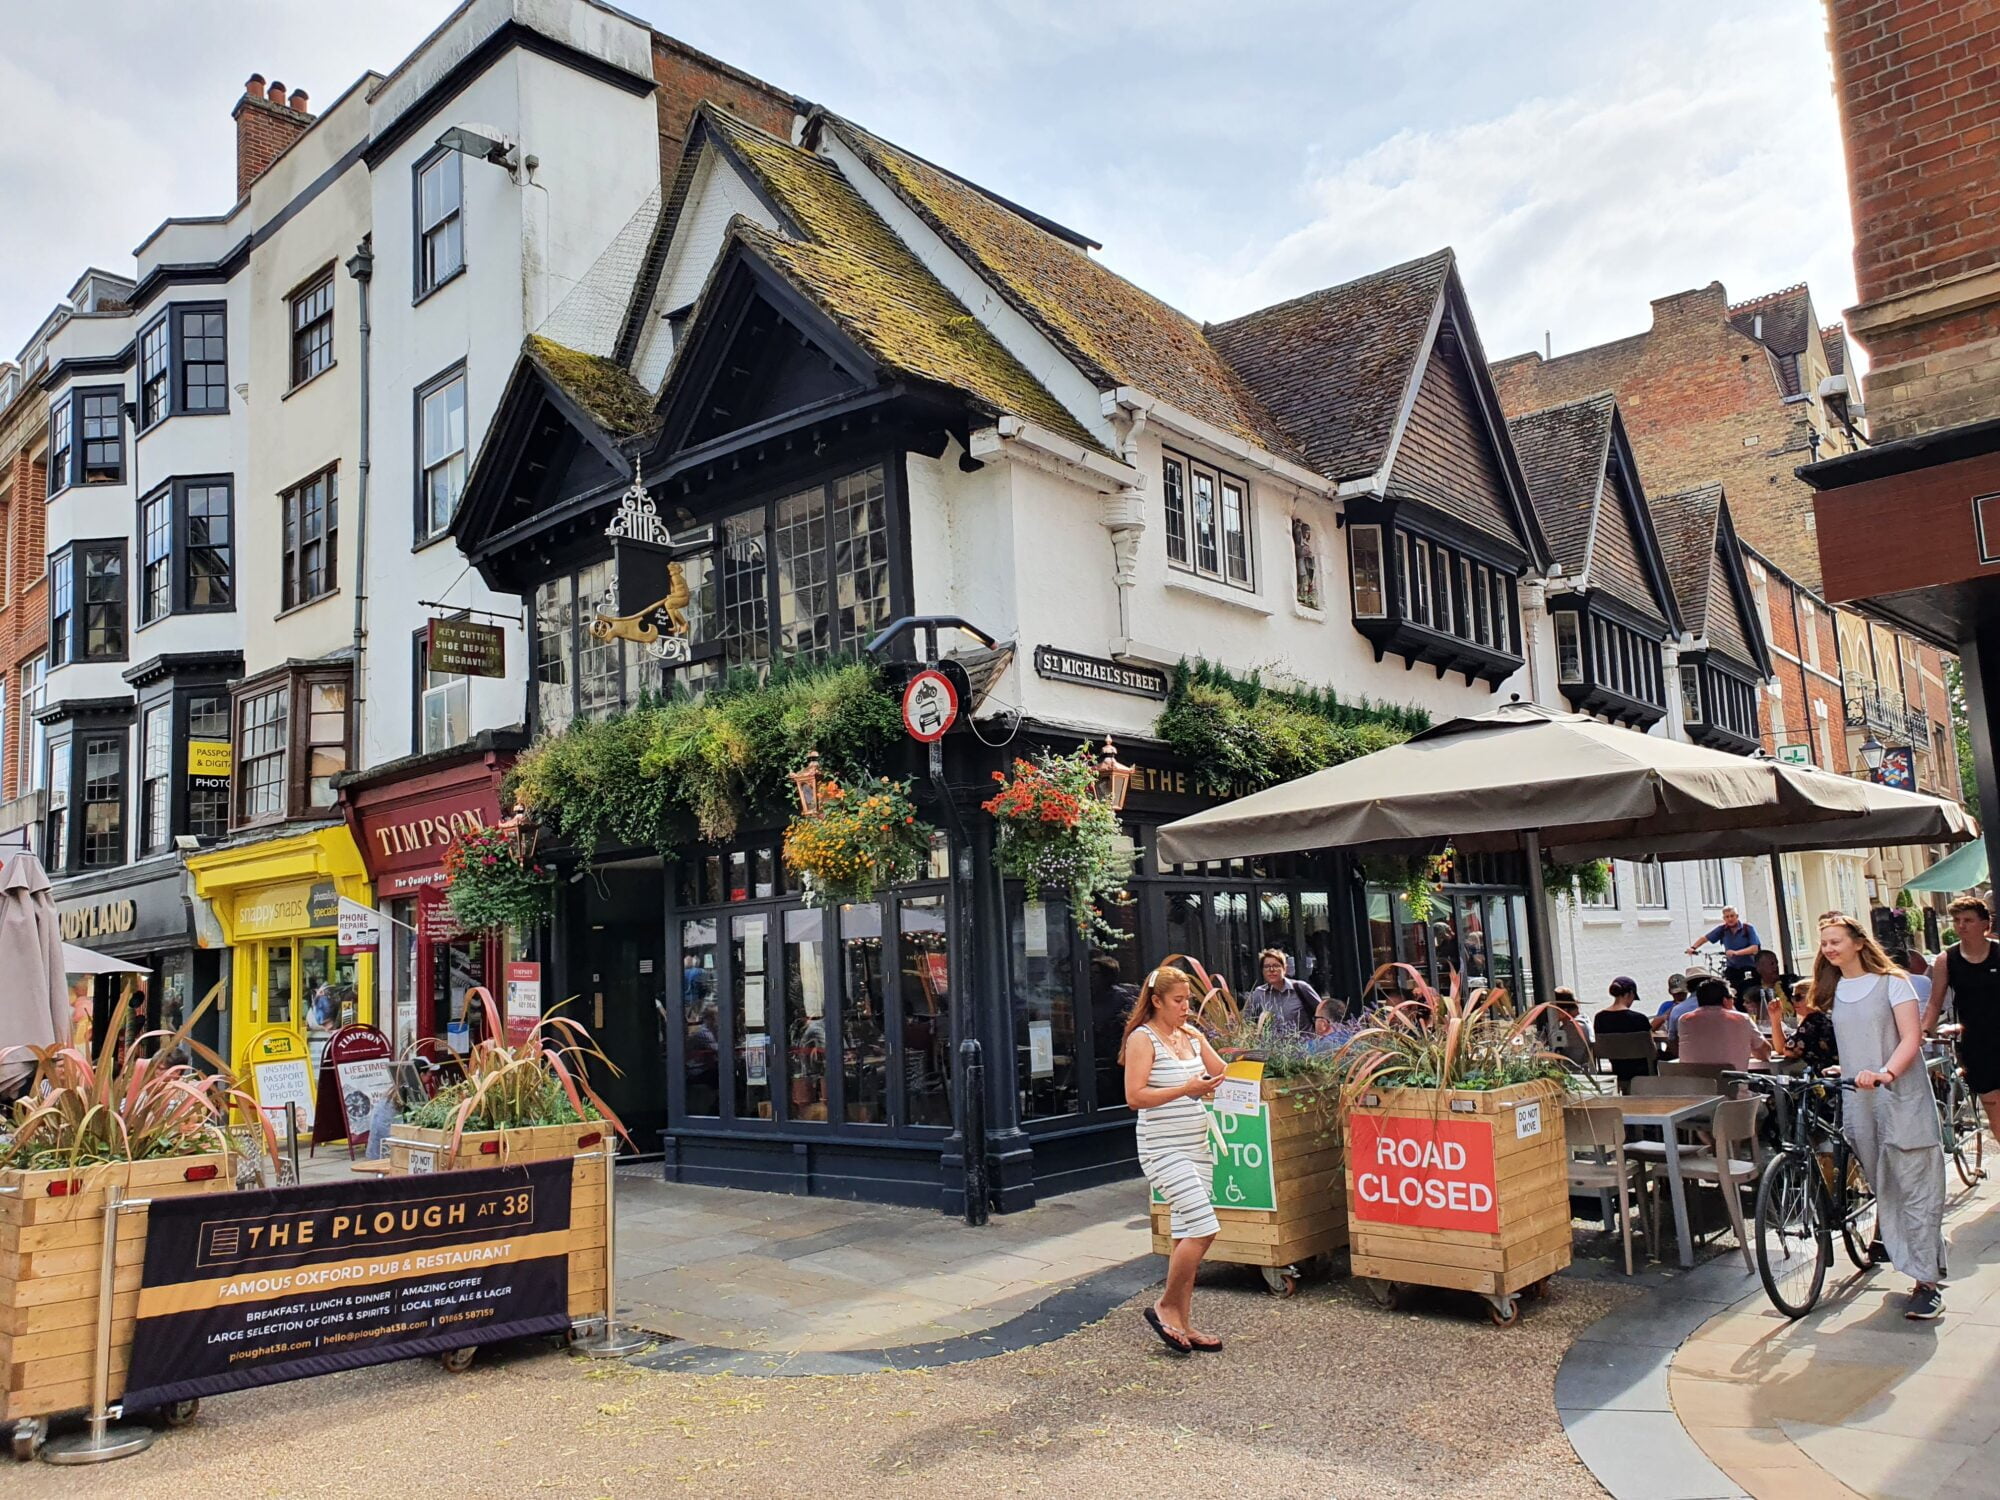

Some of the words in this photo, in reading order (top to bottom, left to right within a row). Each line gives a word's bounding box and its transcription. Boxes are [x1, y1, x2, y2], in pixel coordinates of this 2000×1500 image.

[435, 640, 459, 651] SHOE
[1061, 657, 1121, 684] MICHAEL'S
[1122, 673, 1161, 692] STREET
[1146, 768, 1185, 794] THE
[376, 807, 485, 856] TIMPSON
[395, 878, 406, 888] The
[408, 875, 432, 888] Quality
[339, 921, 368, 930] REPAIRS
[340, 913, 368, 922] PHONE
[338, 1031, 382, 1049] TIMPSON
[265, 1063, 300, 1074] INSTANT
[344, 1061, 387, 1075] LIFETIME
[264, 1071, 304, 1083] PASSPORT
[266, 1083, 285, 1091] VISA
[270, 1089, 304, 1100] PHOTOS
[1519, 1111, 1526, 1121] DO
[1527, 1108, 1538, 1119] NOT
[1522, 1121, 1537, 1132] MOVE
[420, 1156, 431, 1167] NOT
[1227, 1143, 1263, 1168] TO
[1376, 1137, 1466, 1171] ROAD
[1358, 1172, 1493, 1213] CLOSED
[248, 1220, 314, 1249] THE
[332, 1203, 466, 1239] PLOUGH
[477, 1202, 497, 1217] AT
[502, 1193, 529, 1216] 38
[218, 1275, 292, 1298] FAMOUS
[295, 1265, 364, 1286] OXFORD
[369, 1260, 399, 1277] PUB
[402, 1258, 411, 1271] &
[416, 1244, 512, 1269] RESTAURANT
[246, 1304, 307, 1322] BREAKFAST,
[310, 1298, 343, 1312] LUNCH
[345, 1296, 352, 1306] &
[355, 1290, 391, 1305] DINNER
[401, 1282, 447, 1297] AMAZING
[448, 1277, 482, 1289] COFFEE
[207, 1330, 244, 1344] LARGE
[247, 1321, 304, 1338] SELECTION
[305, 1317, 319, 1328] OF
[321, 1314, 345, 1325] GINS
[347, 1312, 354, 1321] &
[356, 1305, 390, 1320] SPIRITS
[401, 1300, 432, 1312] LOCAL
[434, 1296, 456, 1307] REAL
[458, 1292, 474, 1302] ALE
[476, 1290, 482, 1299] &
[484, 1286, 512, 1298] LAGER
[229, 1340, 311, 1363] ploughat38.com
[323, 1319, 428, 1345] hello@ploughat38.com
[439, 1314, 464, 1325] 01865
